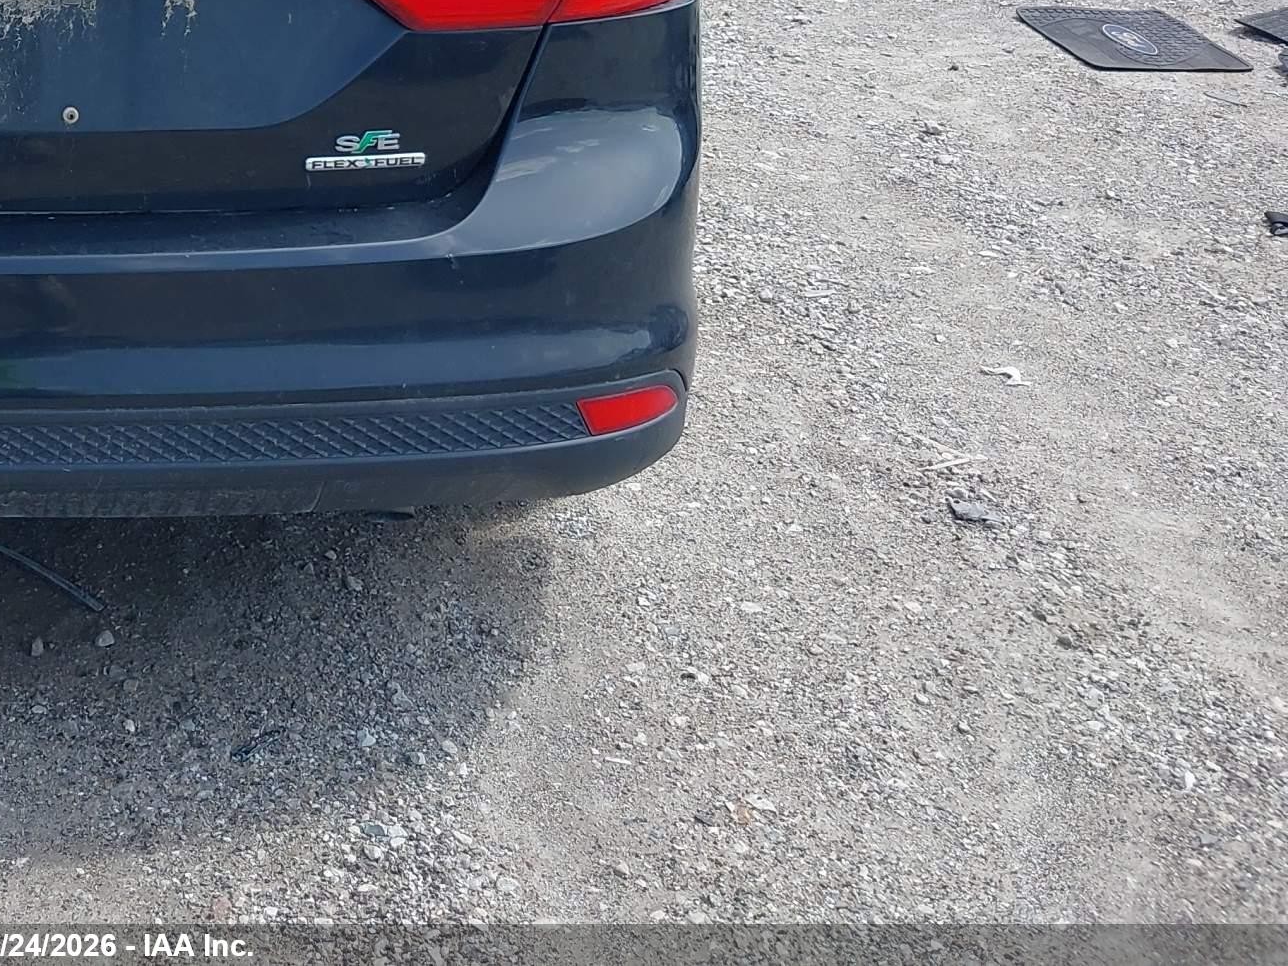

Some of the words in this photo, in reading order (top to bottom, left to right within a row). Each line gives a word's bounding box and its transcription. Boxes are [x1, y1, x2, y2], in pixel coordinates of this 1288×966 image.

[334, 129, 401, 154] SFE
[311, 159, 360, 170] FLEX
[374, 155, 424, 167] FUEL
